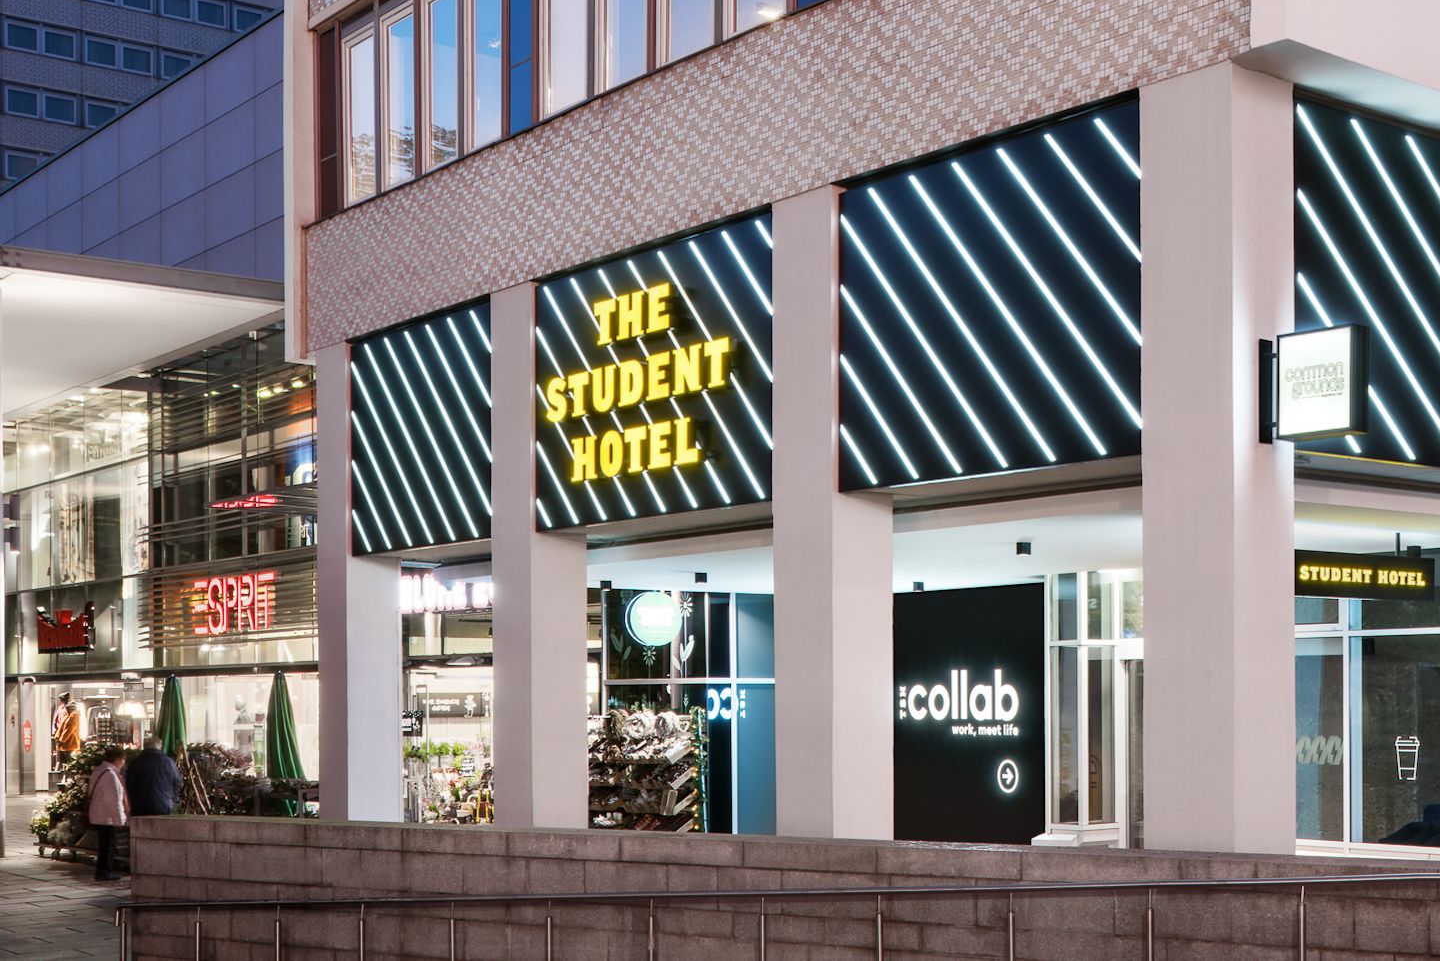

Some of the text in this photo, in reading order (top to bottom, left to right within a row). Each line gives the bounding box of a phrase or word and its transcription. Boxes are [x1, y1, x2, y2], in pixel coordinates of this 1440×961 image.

[593, 282, 671, 346] THE
[545, 336, 731, 425] STUDENT
[1284, 361, 1344, 382] common
[1291, 377, 1345, 400] grounds
[570, 416, 700, 484] HOTEL
[193, 570, 277, 635] ESPRIT
[1299, 565, 1426, 587] STUDENT HOTEL
[907, 668, 1020, 721] collab
[978, 726, 1002, 736] meet
[1003, 724, 1020, 736] life
